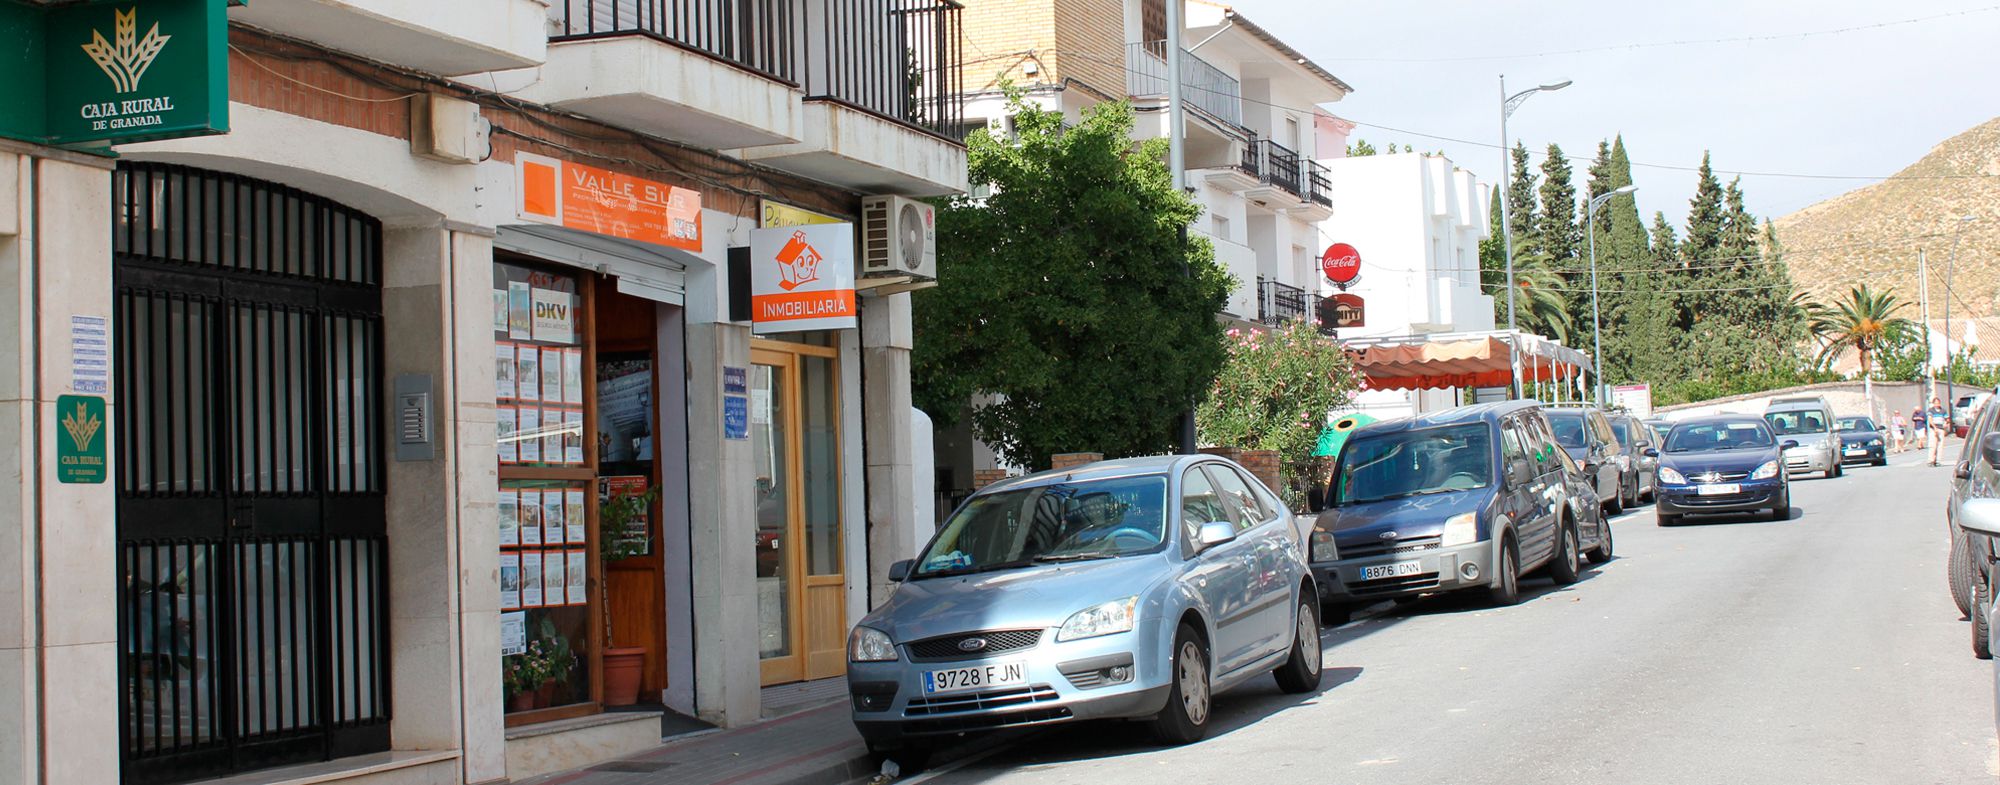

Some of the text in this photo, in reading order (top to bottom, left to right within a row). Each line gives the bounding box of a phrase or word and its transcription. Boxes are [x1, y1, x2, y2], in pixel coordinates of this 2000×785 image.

[81, 96, 174, 119] CAJA RURAL
[92, 115, 163, 131] DE GRANADA
[535, 301, 567, 321] DKV
[762, 298, 847, 318] INMOBILIARIA
[1366, 563, 1419, 578] 8876 DNN
[937, 663, 1021, 689] 9728 FJN
